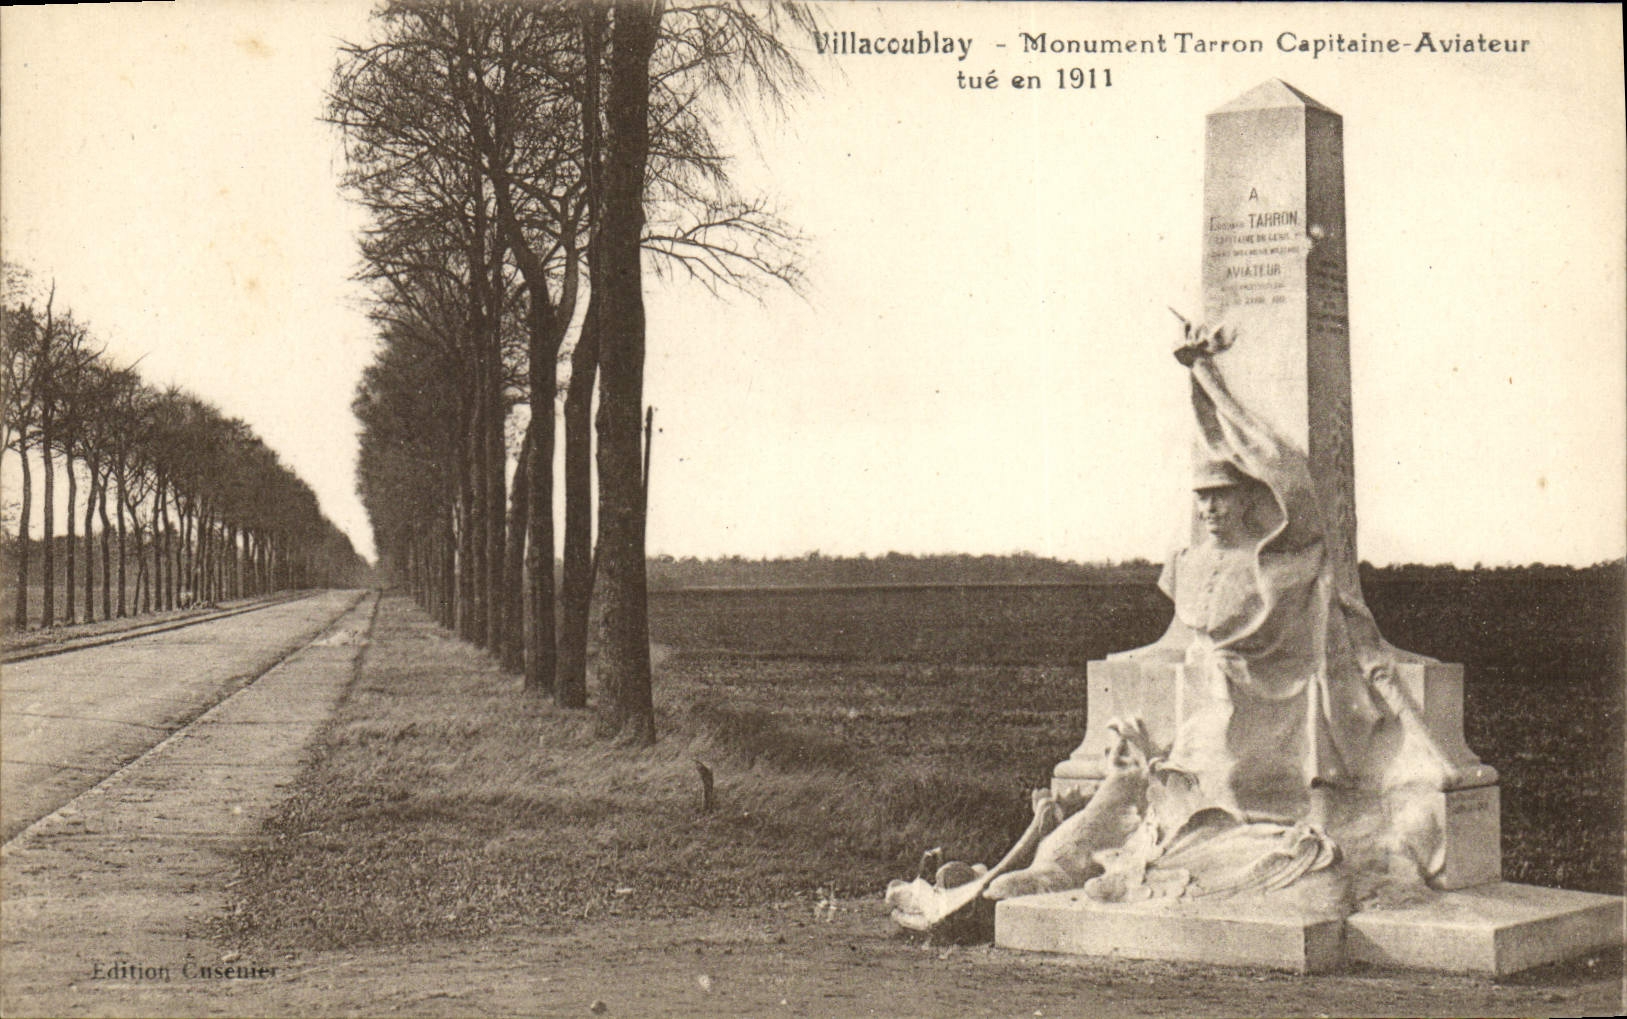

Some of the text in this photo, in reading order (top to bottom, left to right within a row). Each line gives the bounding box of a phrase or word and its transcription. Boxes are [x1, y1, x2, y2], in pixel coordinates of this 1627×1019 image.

[1249, 187, 1259, 201] A
[1248, 211, 1298, 229] TARRON
[1226, 263, 1281, 279] AVIATEUR
